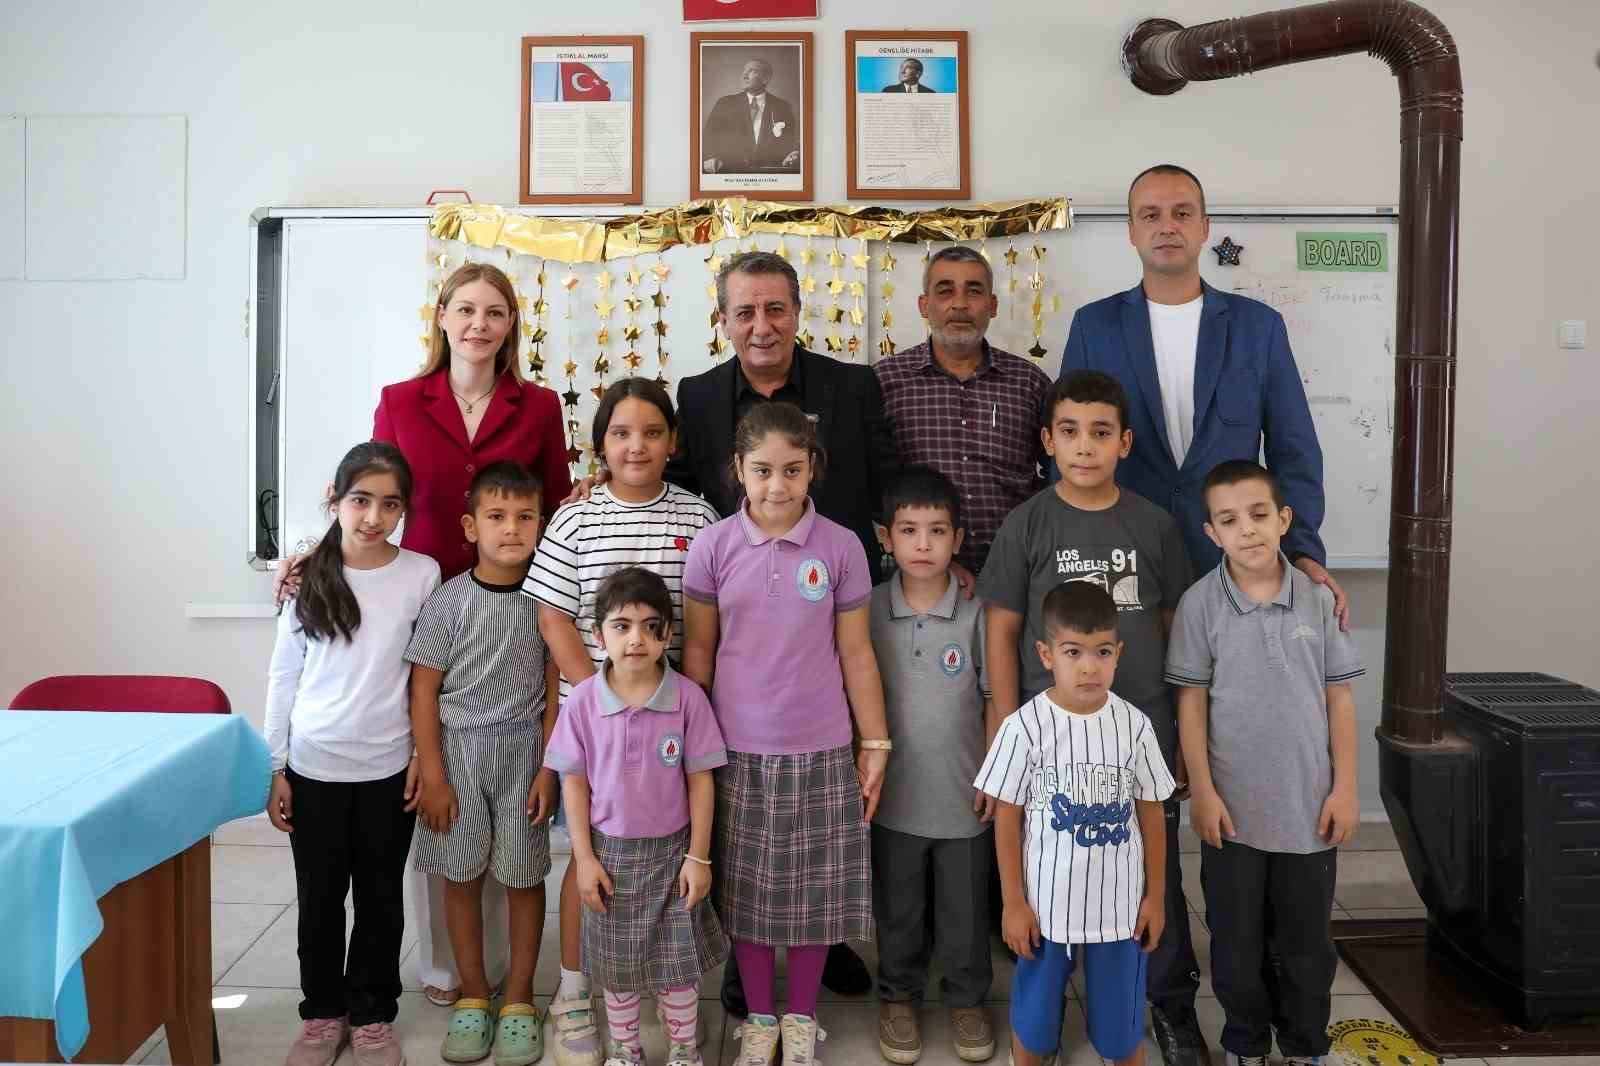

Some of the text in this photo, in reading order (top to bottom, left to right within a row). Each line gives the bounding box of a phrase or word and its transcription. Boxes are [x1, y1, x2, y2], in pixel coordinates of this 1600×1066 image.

[1304, 239, 1382, 266] BOARD
[1056, 549, 1080, 562] LOS
[1057, 548, 1137, 573] ANGELES 91
